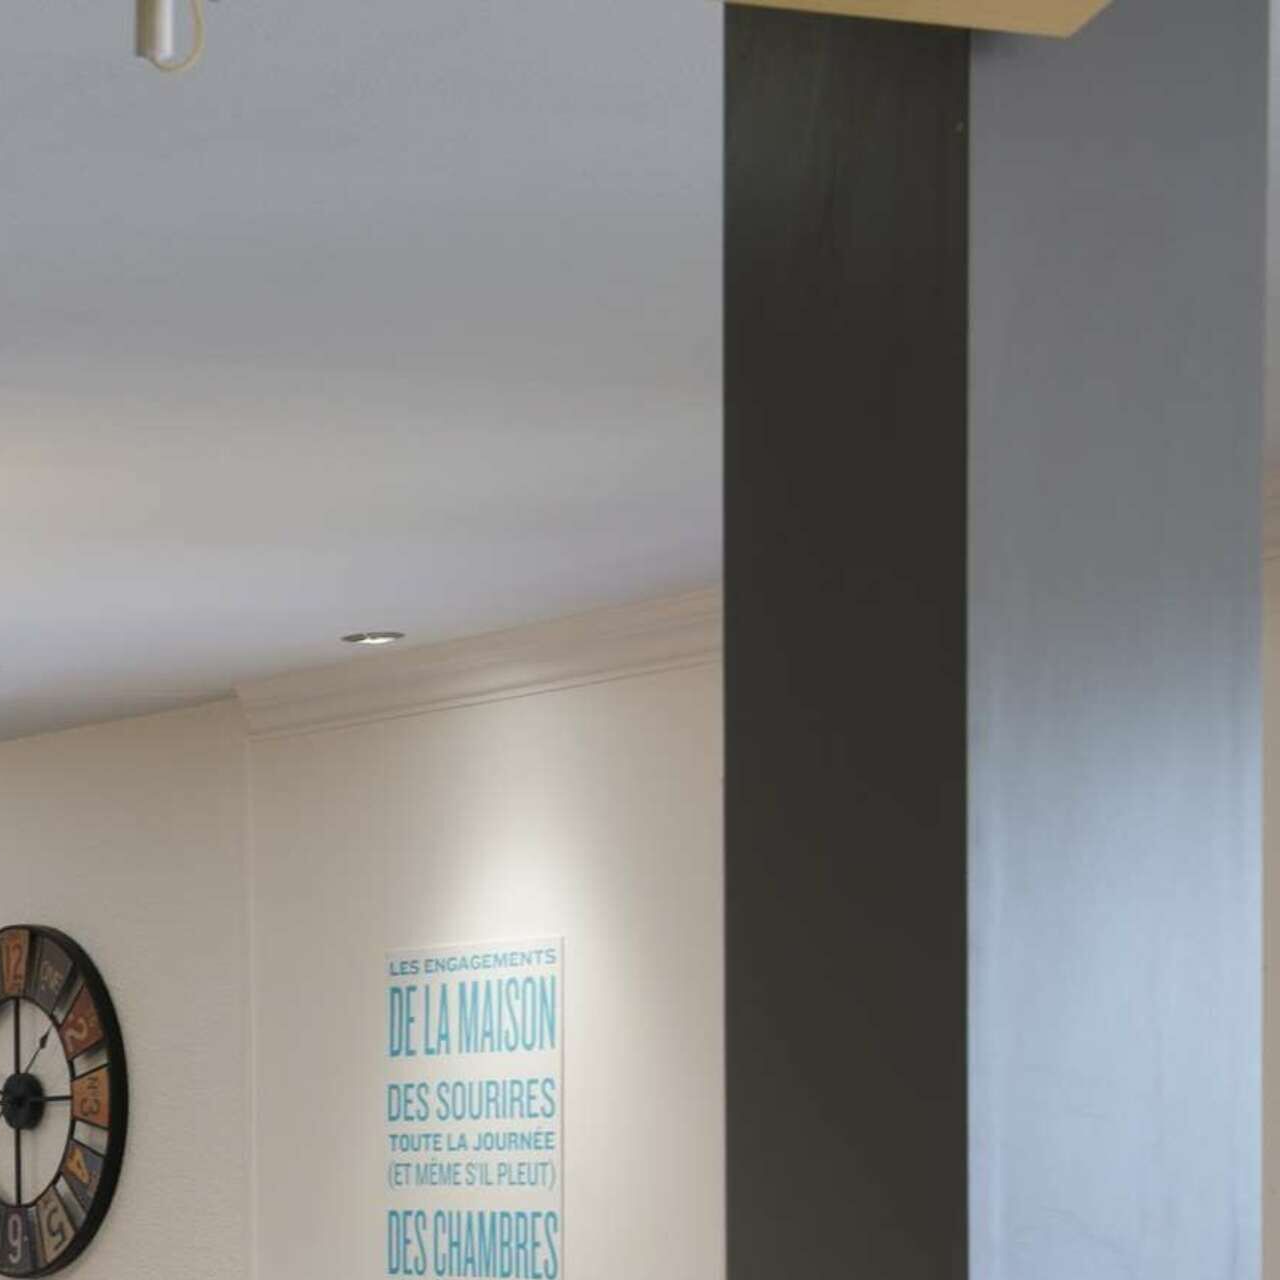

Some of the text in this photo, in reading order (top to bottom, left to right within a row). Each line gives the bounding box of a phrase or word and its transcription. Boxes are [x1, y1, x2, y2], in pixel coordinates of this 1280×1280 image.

[390, 949, 557, 976] LES ENGAGEMENTS
[390, 975, 556, 1056] DE LA MAISON
[388, 1077, 556, 1121] DES SOURIRES
[389, 1127, 556, 1151] TOUTE LA JOURNÉE
[389, 1161, 411, 1190] (ET
[416, 1157, 461, 1186] MÊME
[498, 1160, 556, 1190] PLEUT)
[46, 1208, 67, 1251] 5
[388, 1210, 558, 1280] DES CHAMBRES
